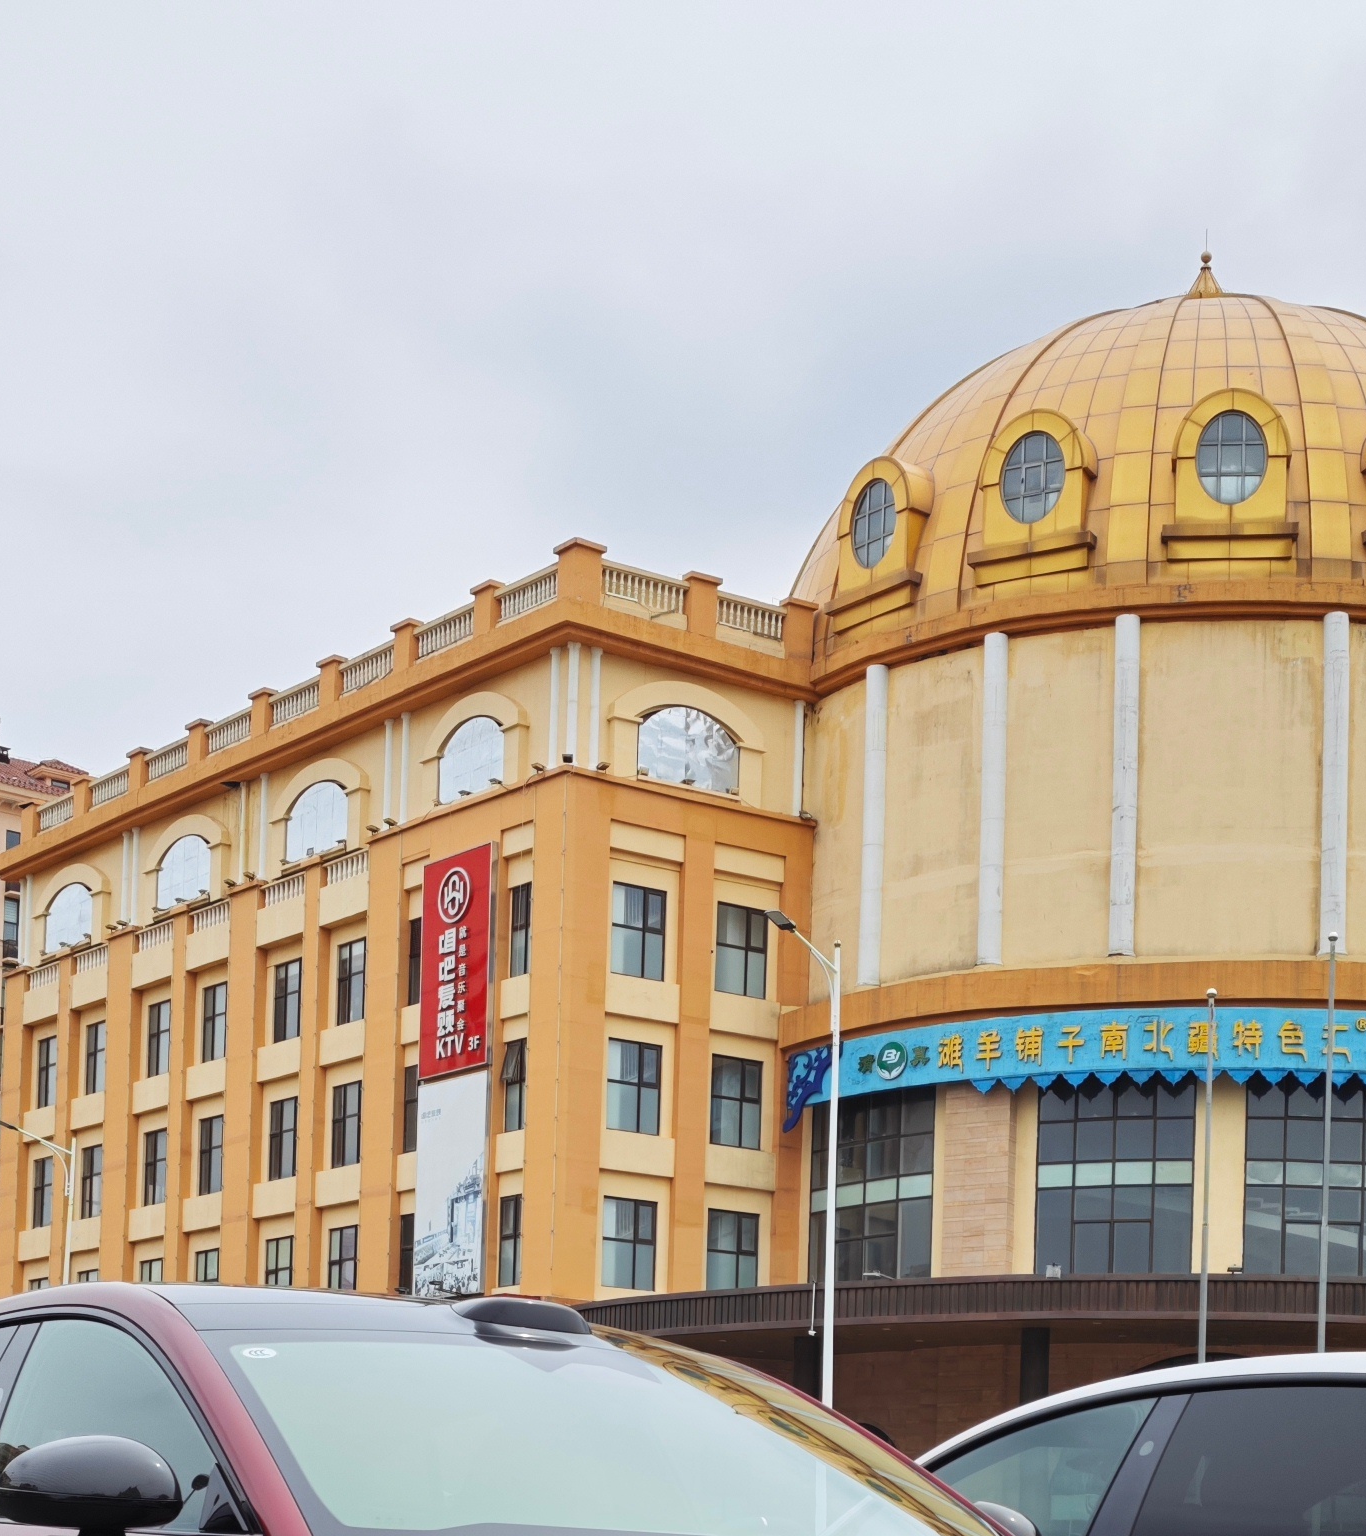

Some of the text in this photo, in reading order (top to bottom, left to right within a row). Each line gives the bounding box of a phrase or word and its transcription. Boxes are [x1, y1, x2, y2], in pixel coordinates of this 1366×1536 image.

[436, 1033, 480, 1060] KTV 3F
[910, 1046, 931, 1068] 真
